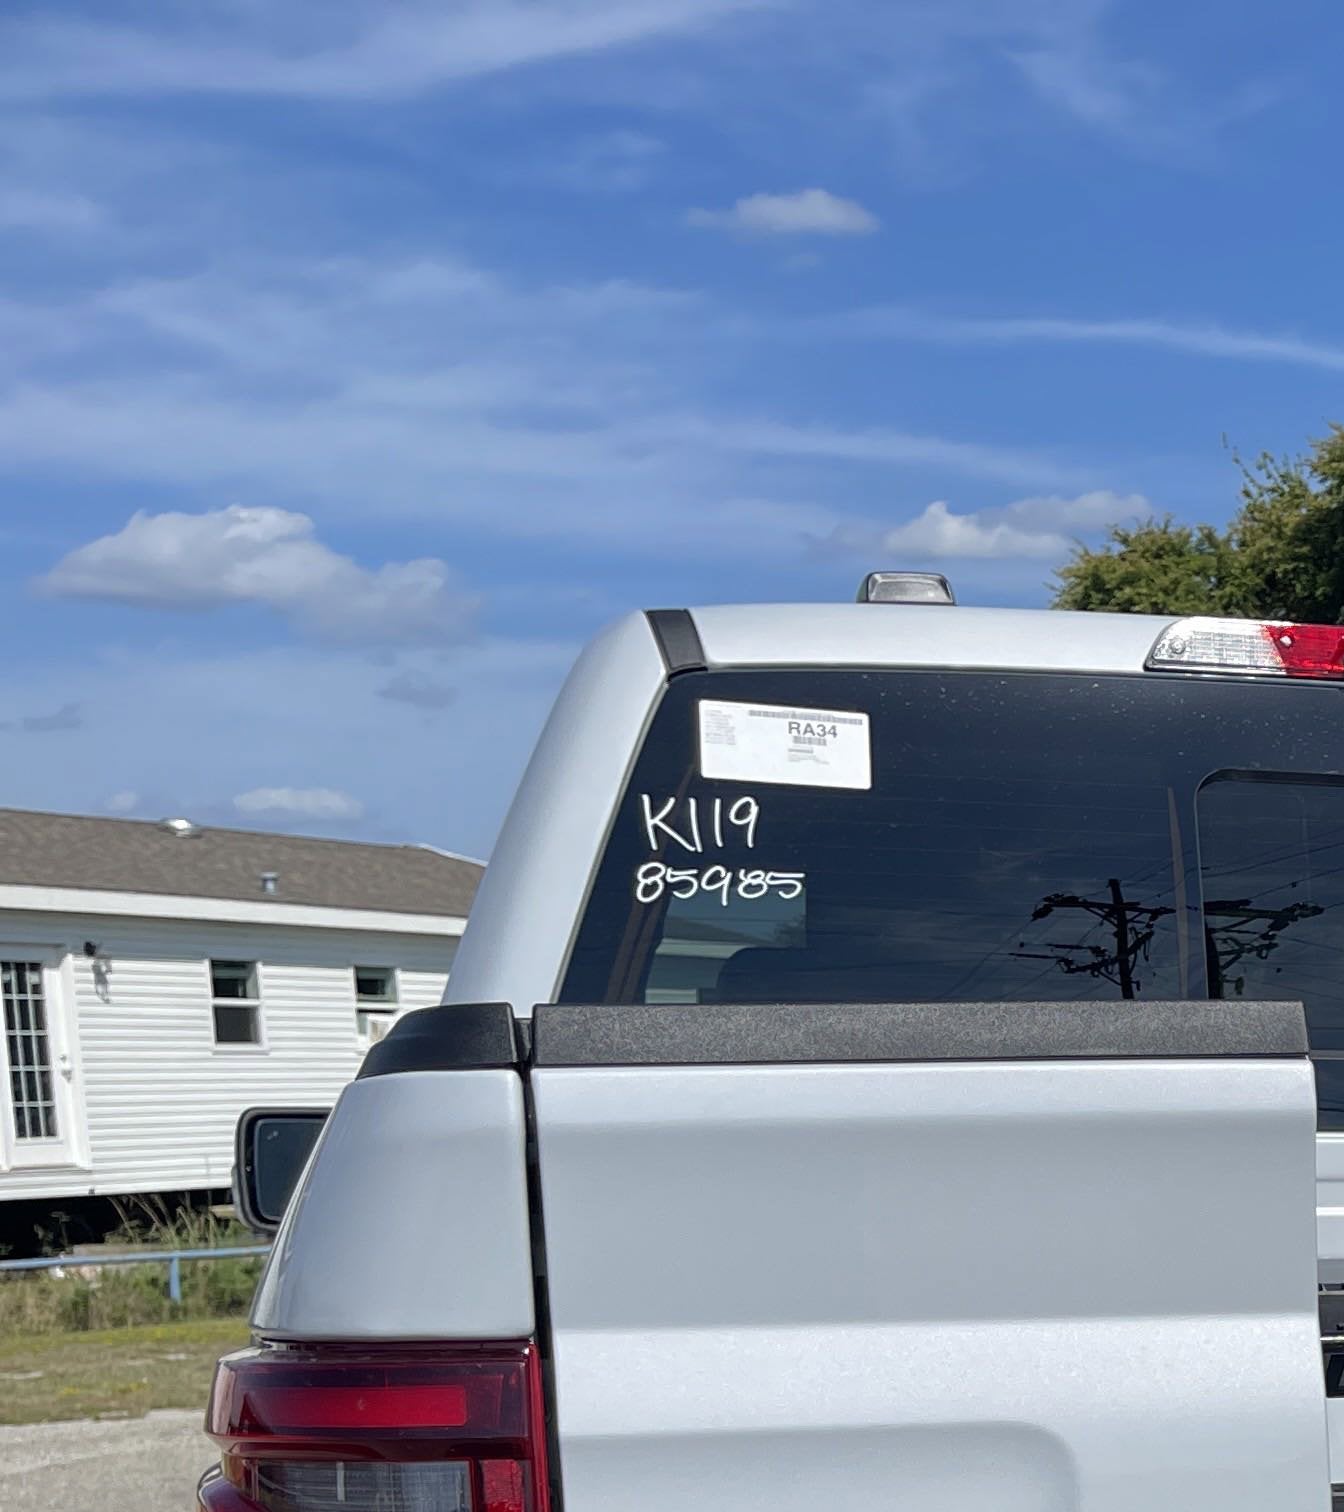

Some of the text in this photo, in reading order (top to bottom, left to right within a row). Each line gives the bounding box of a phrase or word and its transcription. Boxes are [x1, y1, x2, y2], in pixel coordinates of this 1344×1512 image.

[787, 721, 838, 738] RA34
[641, 793, 760, 853] K119
[635, 861, 806, 907] 85985
